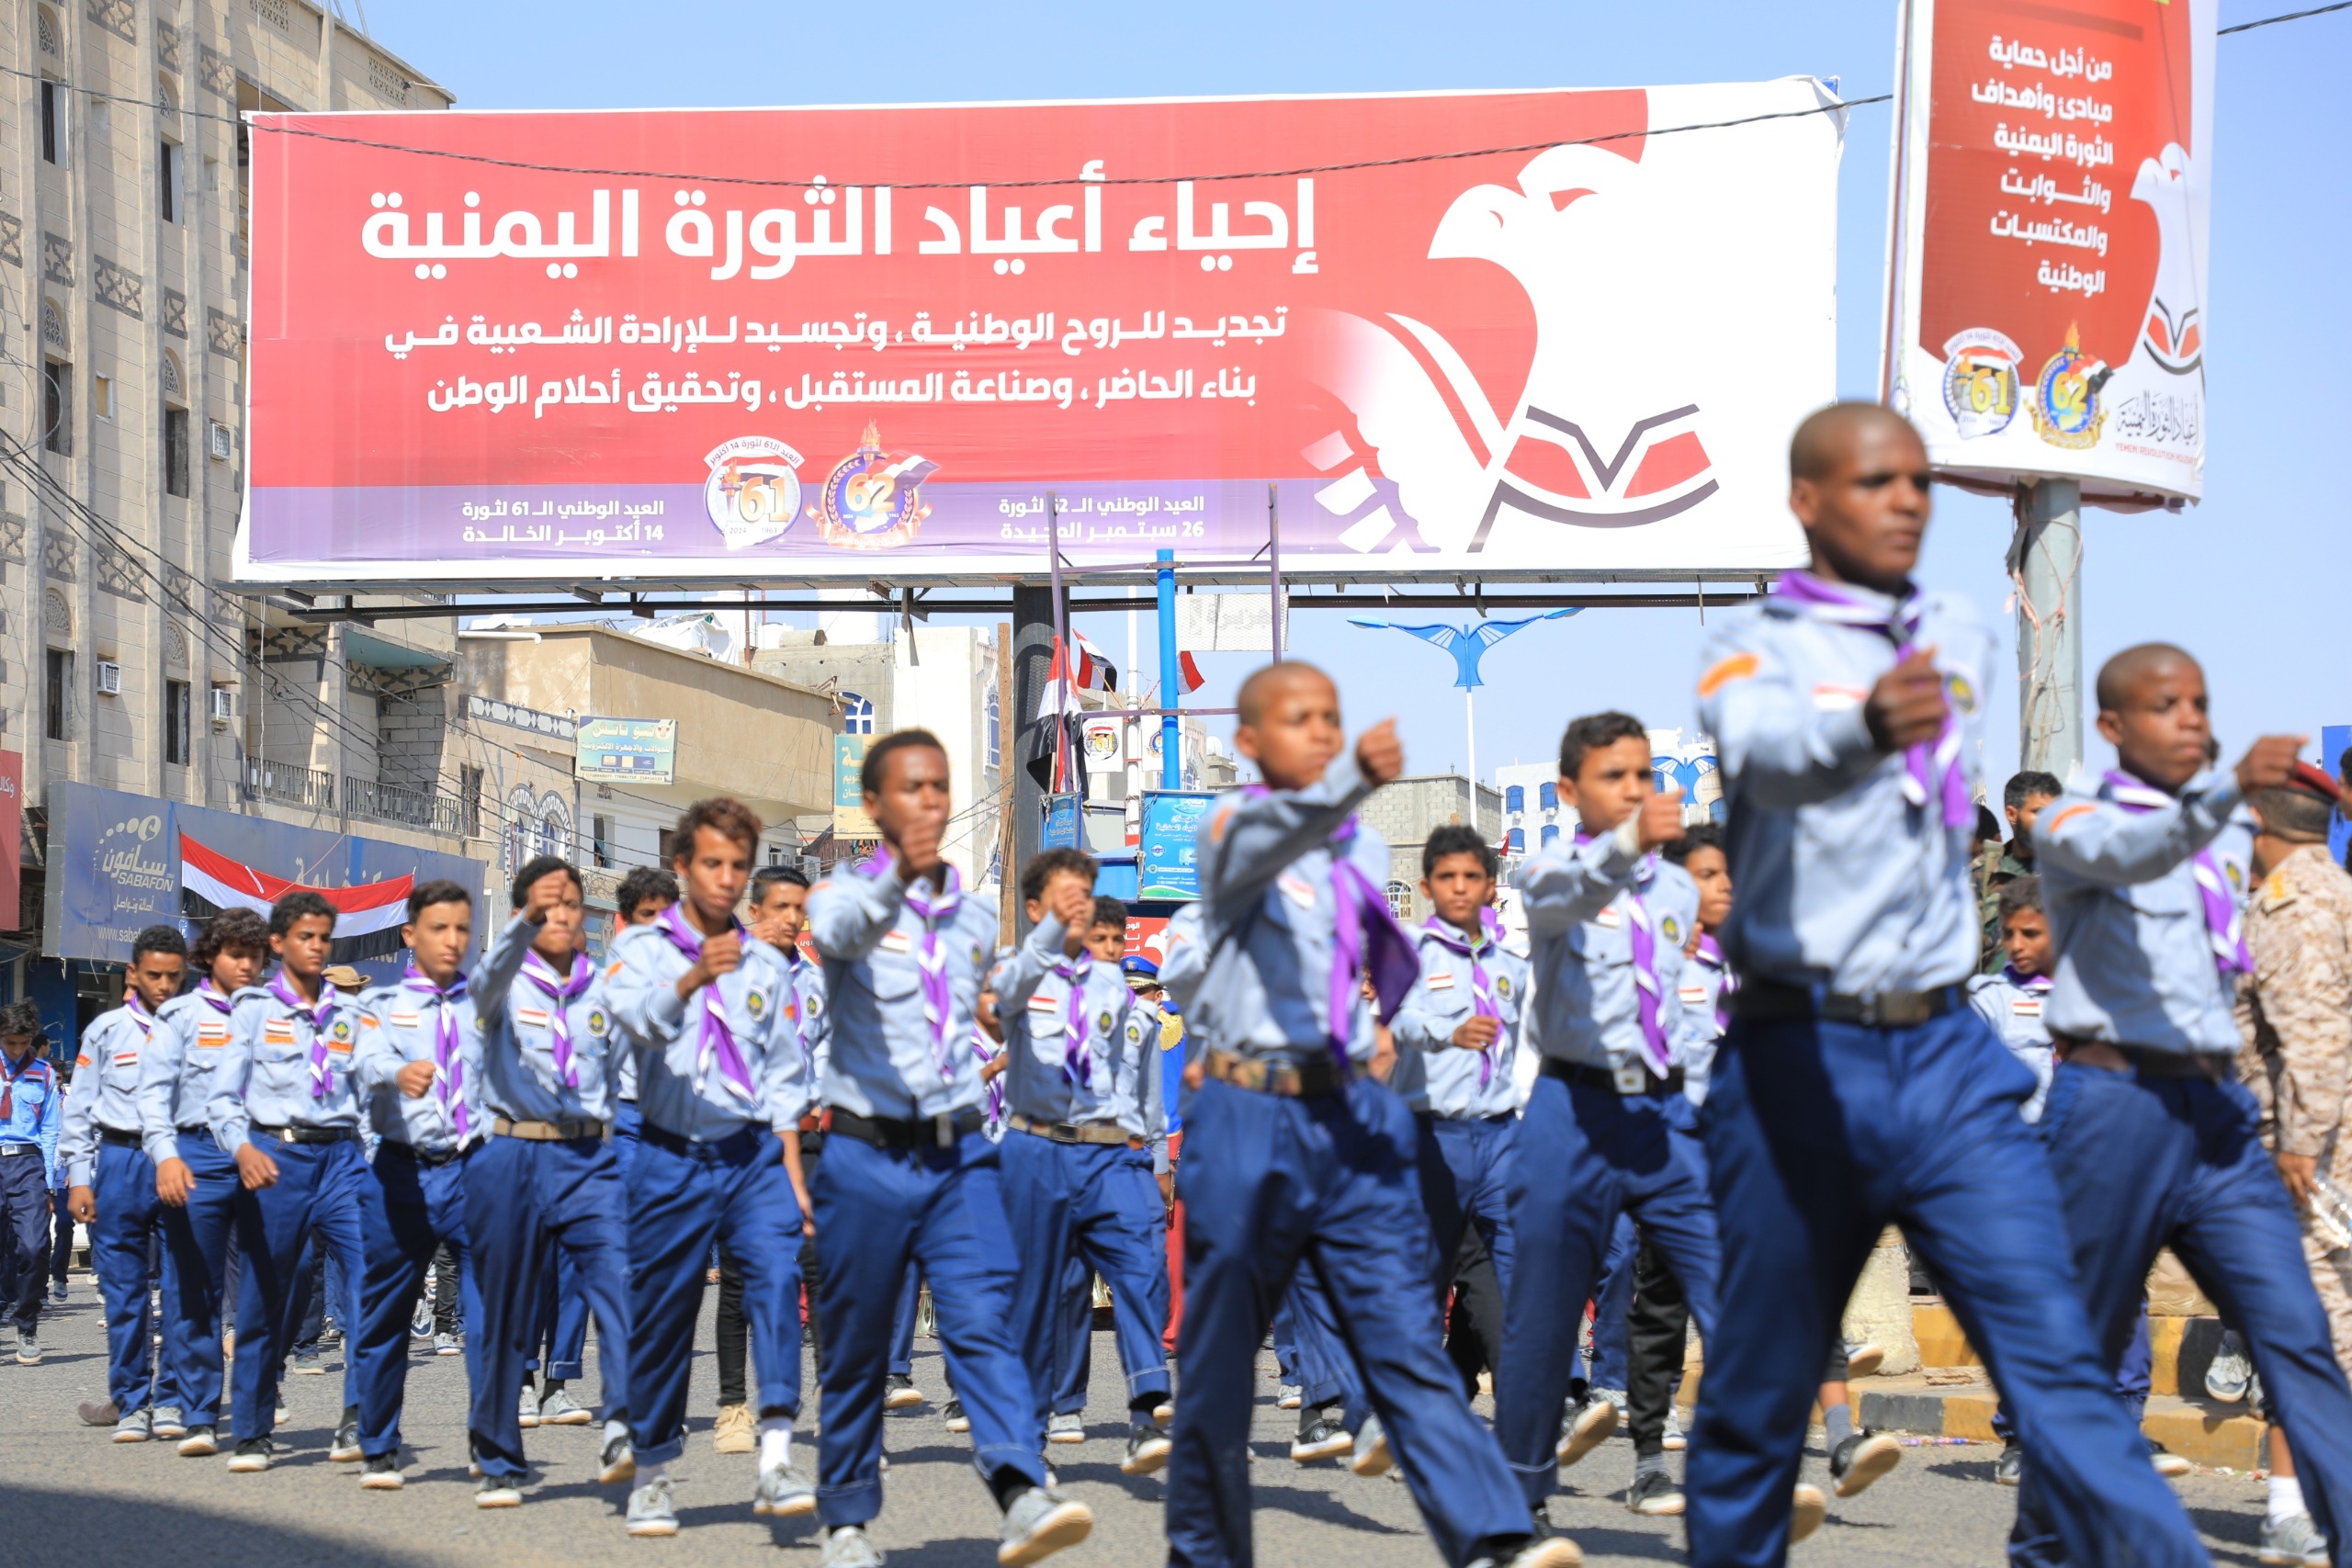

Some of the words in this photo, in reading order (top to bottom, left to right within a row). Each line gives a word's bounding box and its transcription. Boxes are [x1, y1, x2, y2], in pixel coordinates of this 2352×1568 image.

[1989, 35, 2048, 70] حماية
[2050, 47, 2084, 79] أجل
[2086, 56, 2112, 83] من
[1972, 78, 2055, 118] وأهداف
[2057, 96, 2112, 127] مبادئ
[1994, 122, 2064, 161] اليمنية
[2064, 133, 2113, 167] الثورة
[2000, 167, 2112, 214] والثوابت
[361, 188, 639, 280] اليمنية
[665, 175, 891, 280] الثورة
[919, 159, 1106, 275] أعياد
[1128, 179, 1318, 274] إحياء
[1990, 210, 2109, 257] والمكتسبات
[2037, 259, 2106, 298] الوطنية
[385, 315, 459, 360] في
[466, 309, 613, 355] الشعبية
[619, 314, 738, 354] للإرادة
[745, 312, 888, 353] وتجسيد
[910, 311, 1055, 352] الوطنية
[1061, 310, 1166, 356] للروح
[1172, 306, 1289, 346] تجديد
[427, 375, 527, 414] الوطن
[534, 368, 621, 419] أحلام
[627, 371, 762, 412] وتحقيق
[784, 370, 944, 412] المستقبل
[950, 369, 1073, 410] وصناعة
[1094, 368, 1193, 409] الحاضر
[1200, 367, 1256, 406] بناء
[1971, 367, 2011, 415] 61
[2052, 371, 2088, 412] 62
[462, 499, 508, 521] لثورة
[511, 502, 529, 516] 61
[557, 500, 620, 520] الوطني
[623, 500, 664, 519] العيد
[739, 476, 791, 524] 61
[845, 472, 897, 513] 62
[999, 495, 1045, 518] لثورة
[1096, 497, 1159, 516] الوطني
[1163, 496, 1204, 515] العيد
[462, 525, 551, 543] الخالدة
[554, 519, 641, 547] أكتوبر
[644, 525, 664, 541] 14
[761, 526, 778, 535] 1963
[1086, 522, 1177, 544] سبتمبر
[1182, 521, 1204, 537] 26
[592, 721, 628, 739] تاتش
[632, 724, 654, 740] نيو
[1094, 734, 1114, 752] 61
[101, 843, 168, 879] سبافون
[117, 872, 175, 892] SABAFON
[97, 926, 141, 943] www.sabaf
